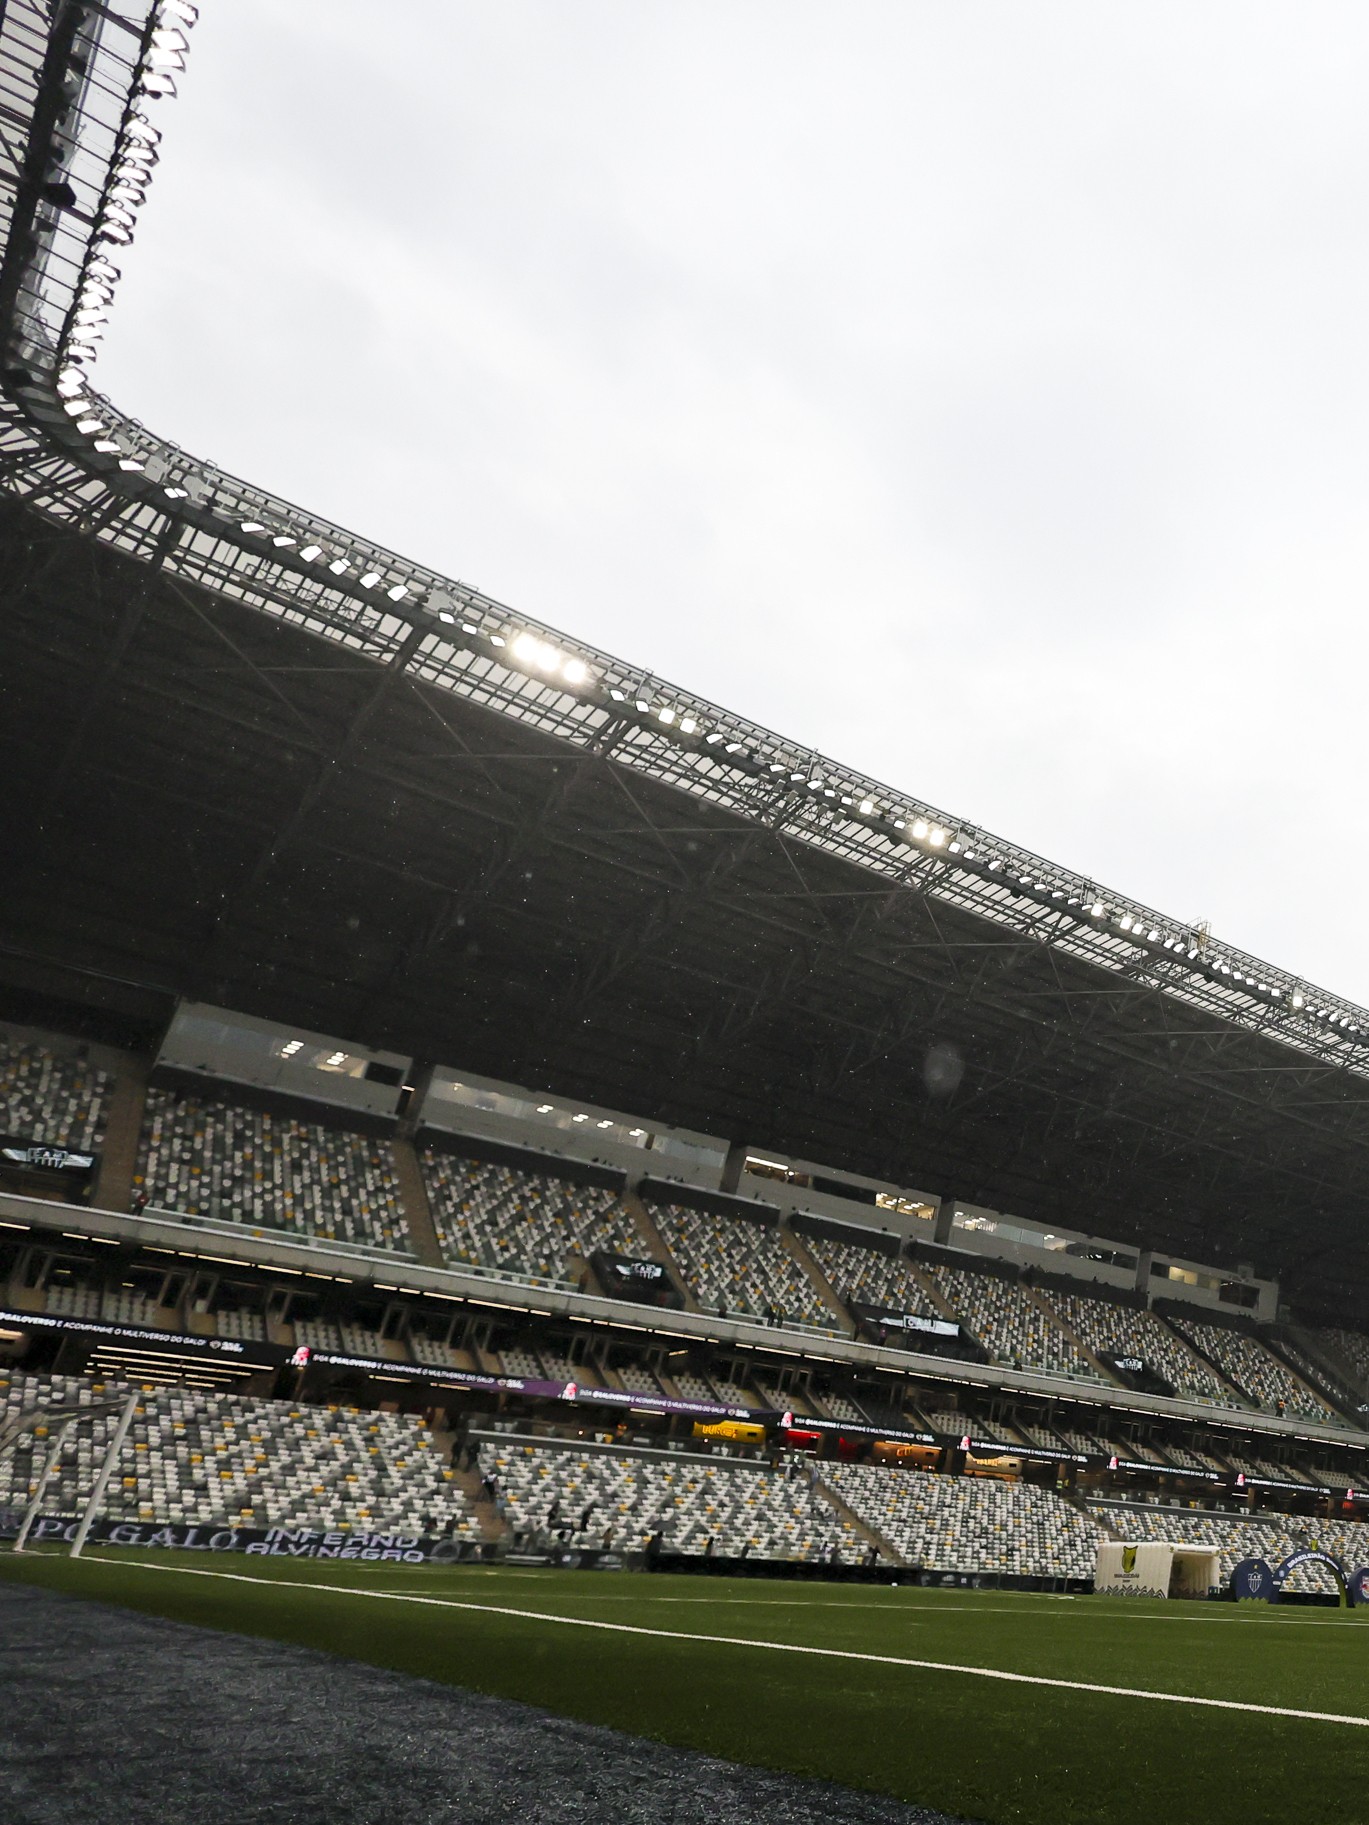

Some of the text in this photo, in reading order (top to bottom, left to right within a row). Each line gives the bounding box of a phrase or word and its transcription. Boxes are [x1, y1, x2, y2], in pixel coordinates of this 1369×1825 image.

[108, 1523, 240, 1550] GALO
[264, 1527, 419, 1549] INFERNO
[245, 1542, 425, 1563] ALVINEGRO
